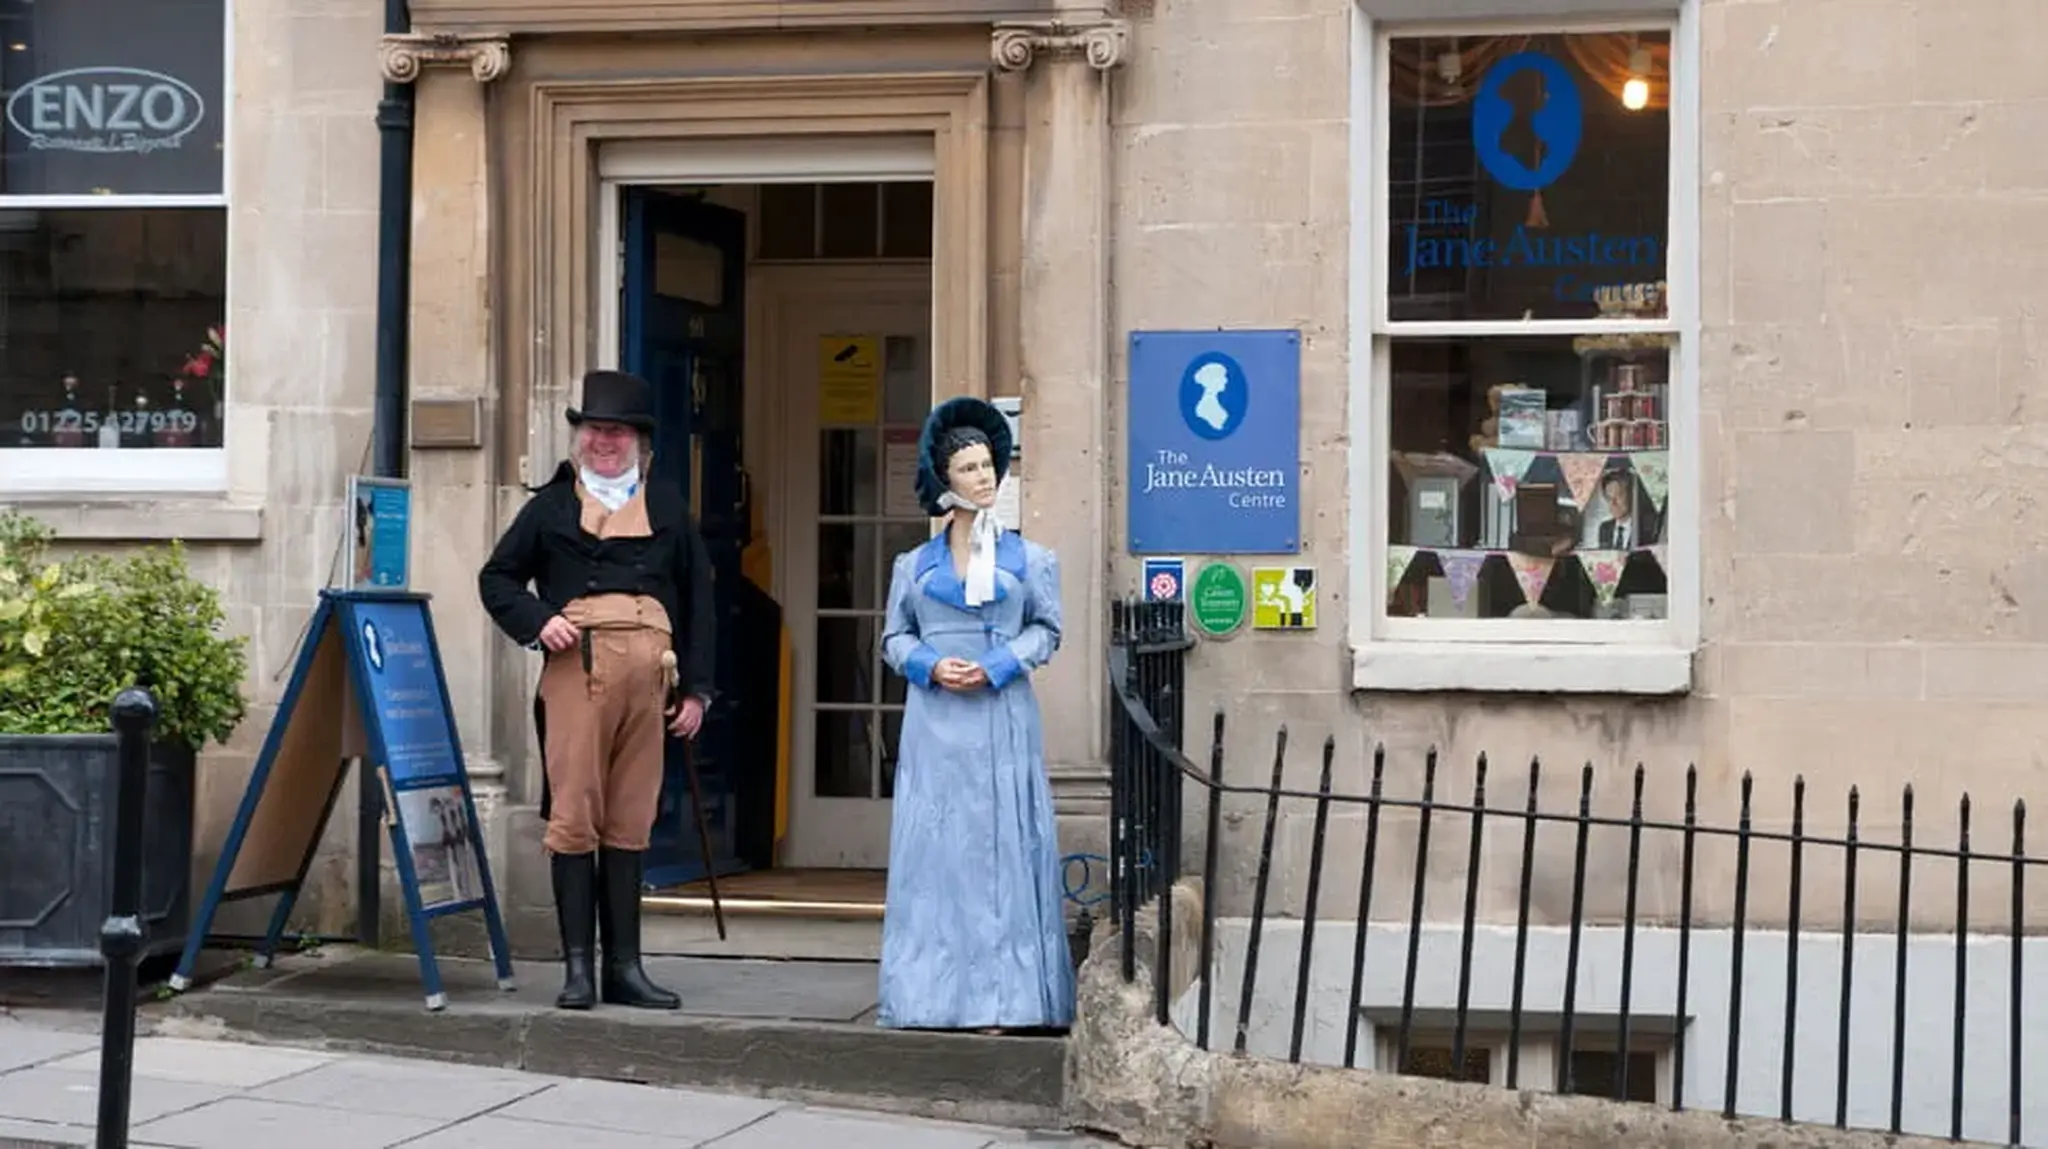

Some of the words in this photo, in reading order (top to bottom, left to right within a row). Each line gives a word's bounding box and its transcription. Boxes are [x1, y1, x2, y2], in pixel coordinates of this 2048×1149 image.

[32, 84, 185, 130] ENZO
[1427, 199, 1477, 225] The
[1404, 224, 1494, 276] Jane
[1502, 224, 1659, 267] Austen
[21, 411, 98, 433] 01225
[1158, 450, 1188, 466] The
[1144, 463, 1197, 493] Jane
[1200, 465, 1285, 488] Austen
[1229, 492, 1286, 508] Centre
